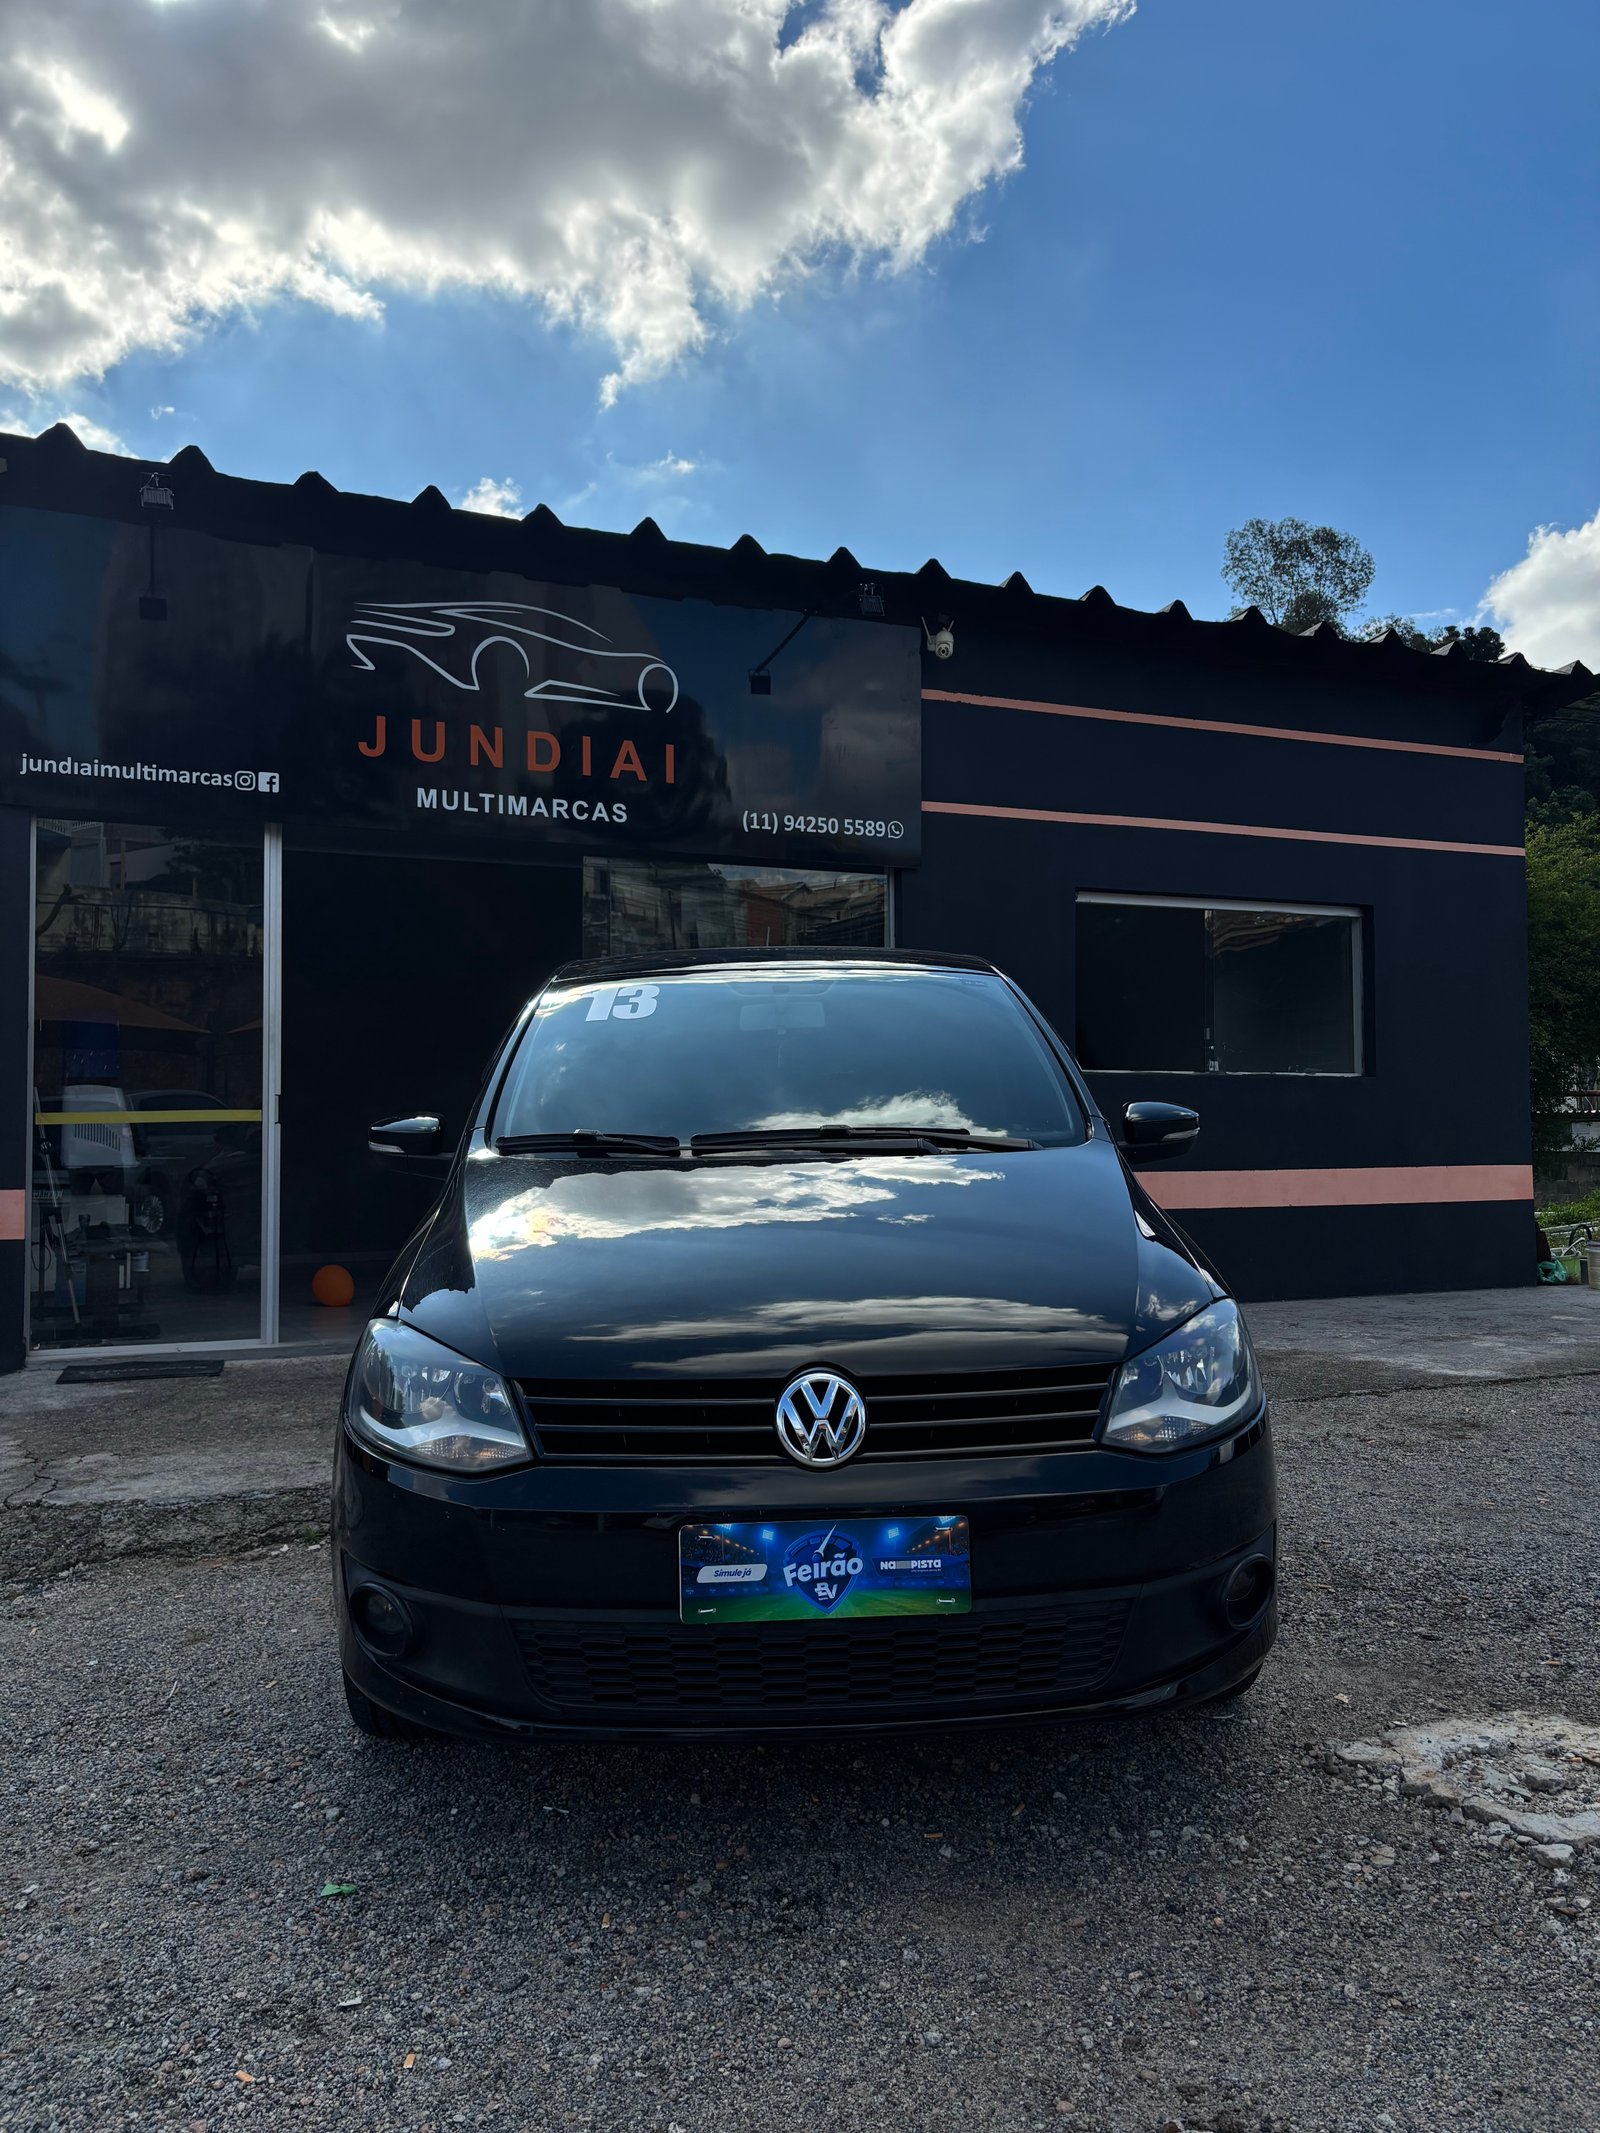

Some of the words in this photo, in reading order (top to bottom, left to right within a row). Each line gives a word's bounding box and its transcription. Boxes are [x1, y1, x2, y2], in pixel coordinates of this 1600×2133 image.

[358, 715, 675, 784] JUNDIAI
[19, 753, 233, 788] jundiaimultimarcas
[417, 787, 628, 823] MULTIMARCAS
[742, 810, 779, 835] (11)
[783, 814, 839, 834] 94250
[843, 818, 886, 837] 5589
[581, 985, 661, 1022] 13
[777, 1372, 866, 1466] VW
[713, 1568, 743, 1578] Simule
[741, 1567, 753, 1578] já
[782, 1552, 864, 1588] Feirão
